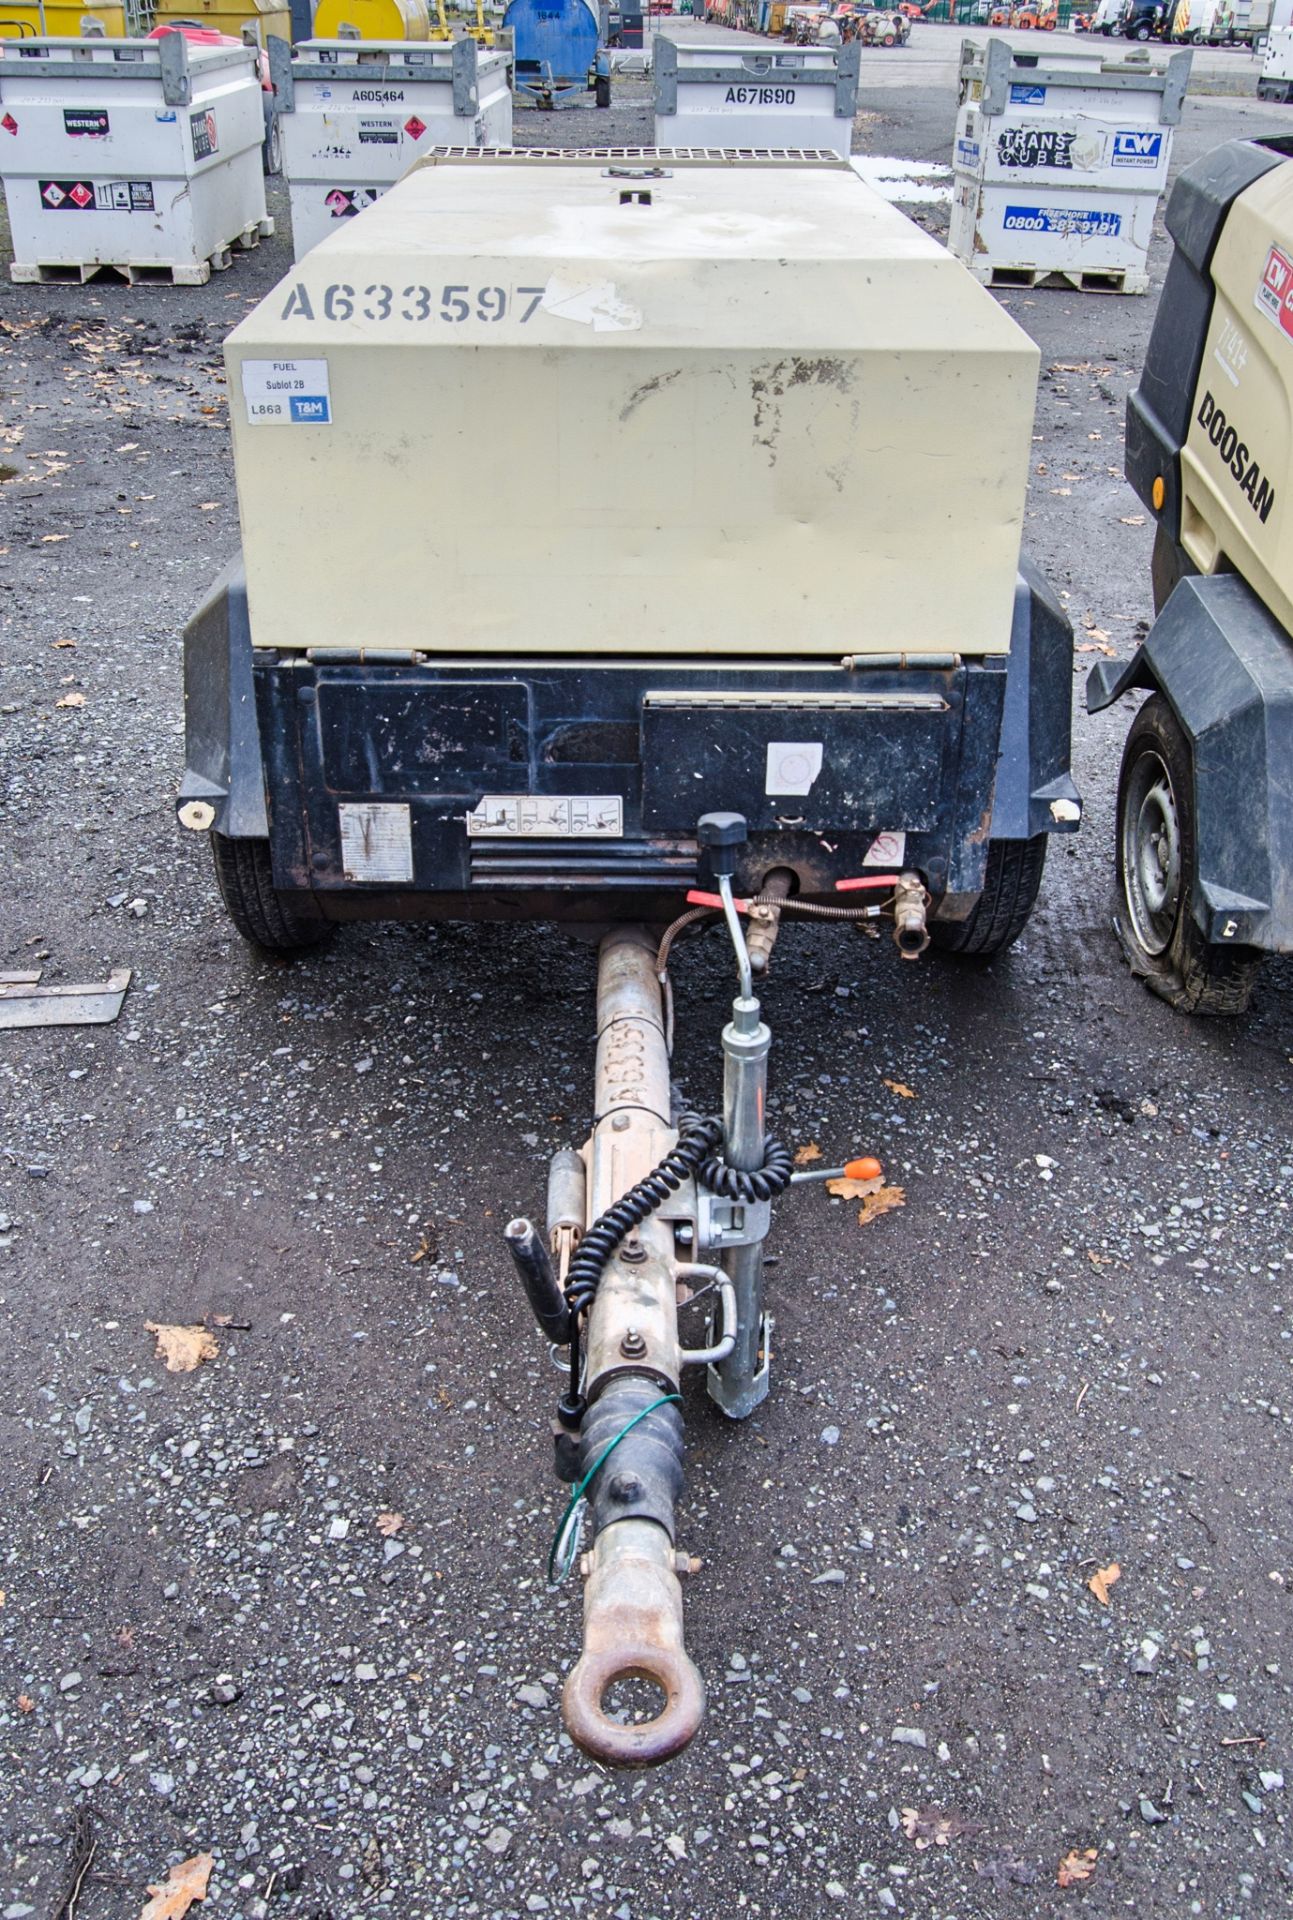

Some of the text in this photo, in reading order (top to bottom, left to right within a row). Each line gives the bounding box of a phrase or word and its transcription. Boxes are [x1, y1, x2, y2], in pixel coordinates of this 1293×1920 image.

[352, 90, 405, 102] A605464
[725, 87, 796, 105] A671890
[1003, 132, 1066, 150] TRANS
[1000, 148, 1068, 165] CUBE
[1005, 216, 1045, 230] 0800
[1081, 220, 1118, 235] 9191
[281, 283, 546, 323] A633597
[273, 363, 297, 371] FUEL
[266, 380, 305, 389] Sublot 2B
[295, 402, 323, 413] T&M
[1197, 389, 1275, 525] DOOSAN
